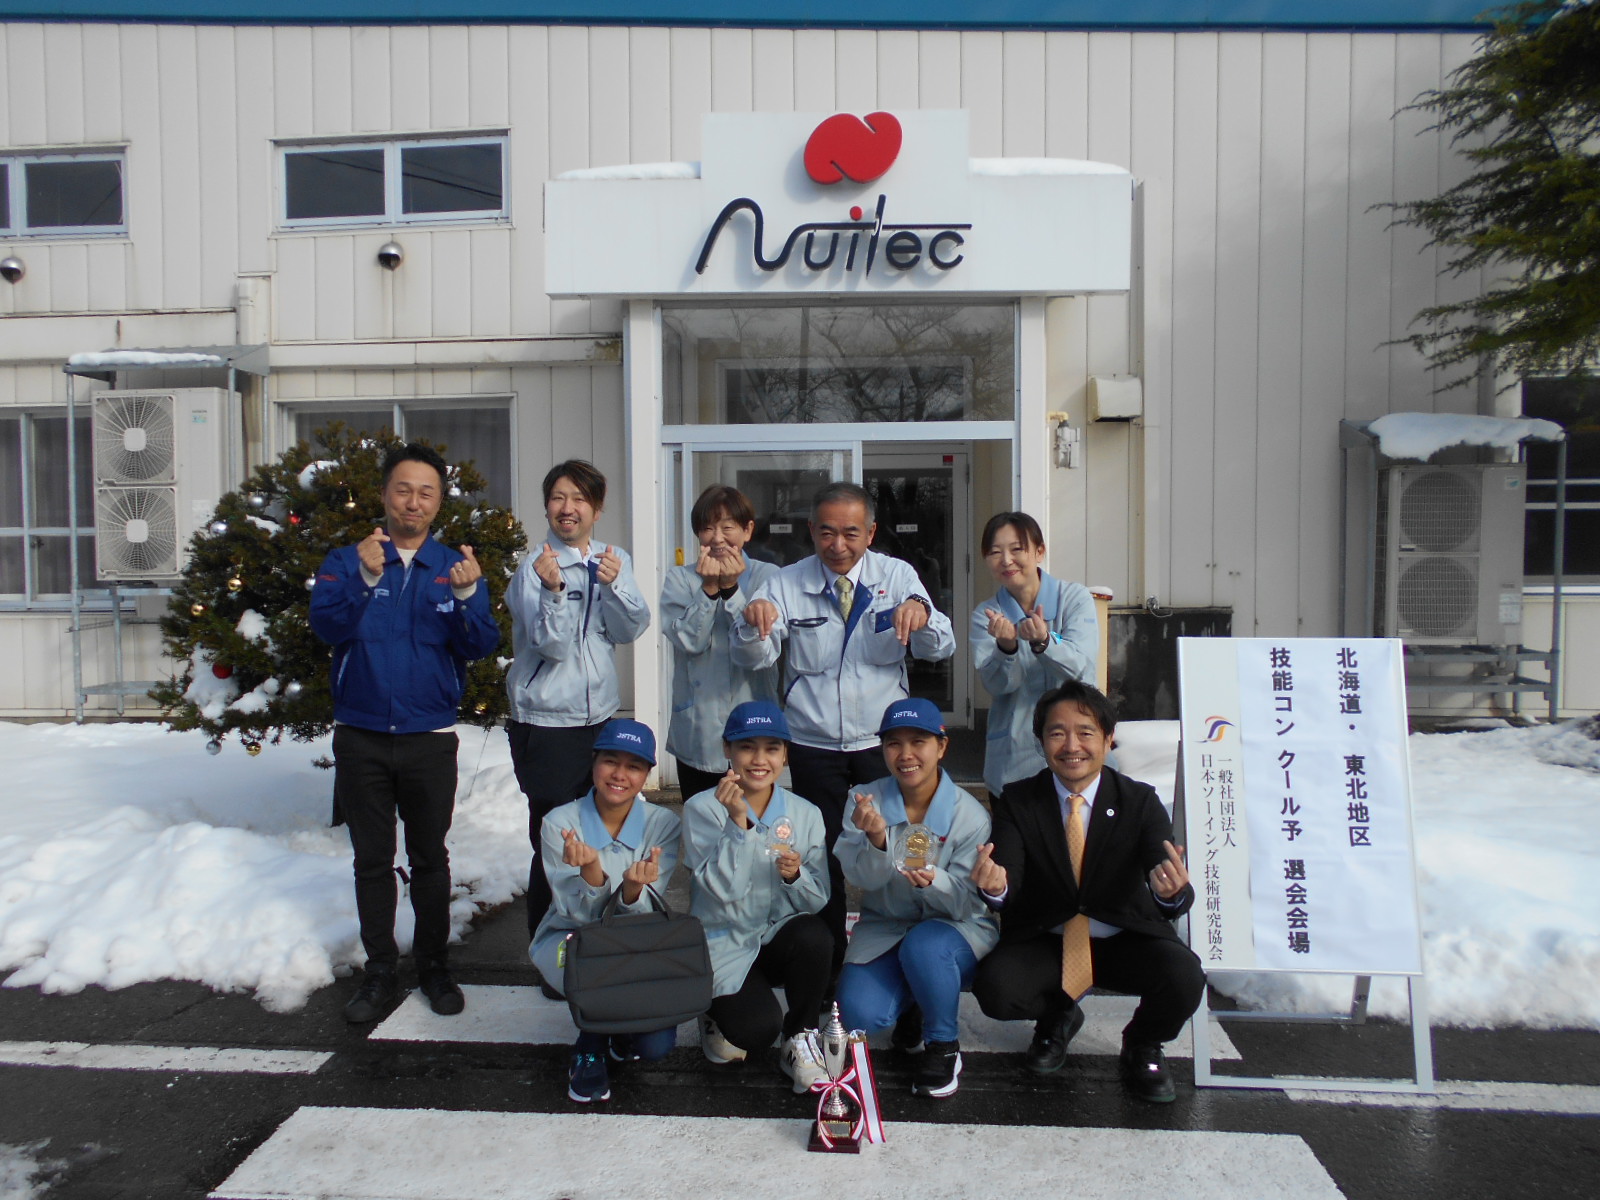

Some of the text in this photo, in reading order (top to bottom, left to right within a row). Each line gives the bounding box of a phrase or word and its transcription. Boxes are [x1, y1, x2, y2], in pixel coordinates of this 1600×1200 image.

[695, 194, 973, 279] Nuitec
[616, 732, 642, 743] JSTRA
[746, 716, 772, 724] JSTRA
[893, 710, 918, 718] JSTRA
[1218, 757, 1236, 847] 一般社団法人
[1201, 753, 1223, 961] 日本ソーイング技術研究協会
